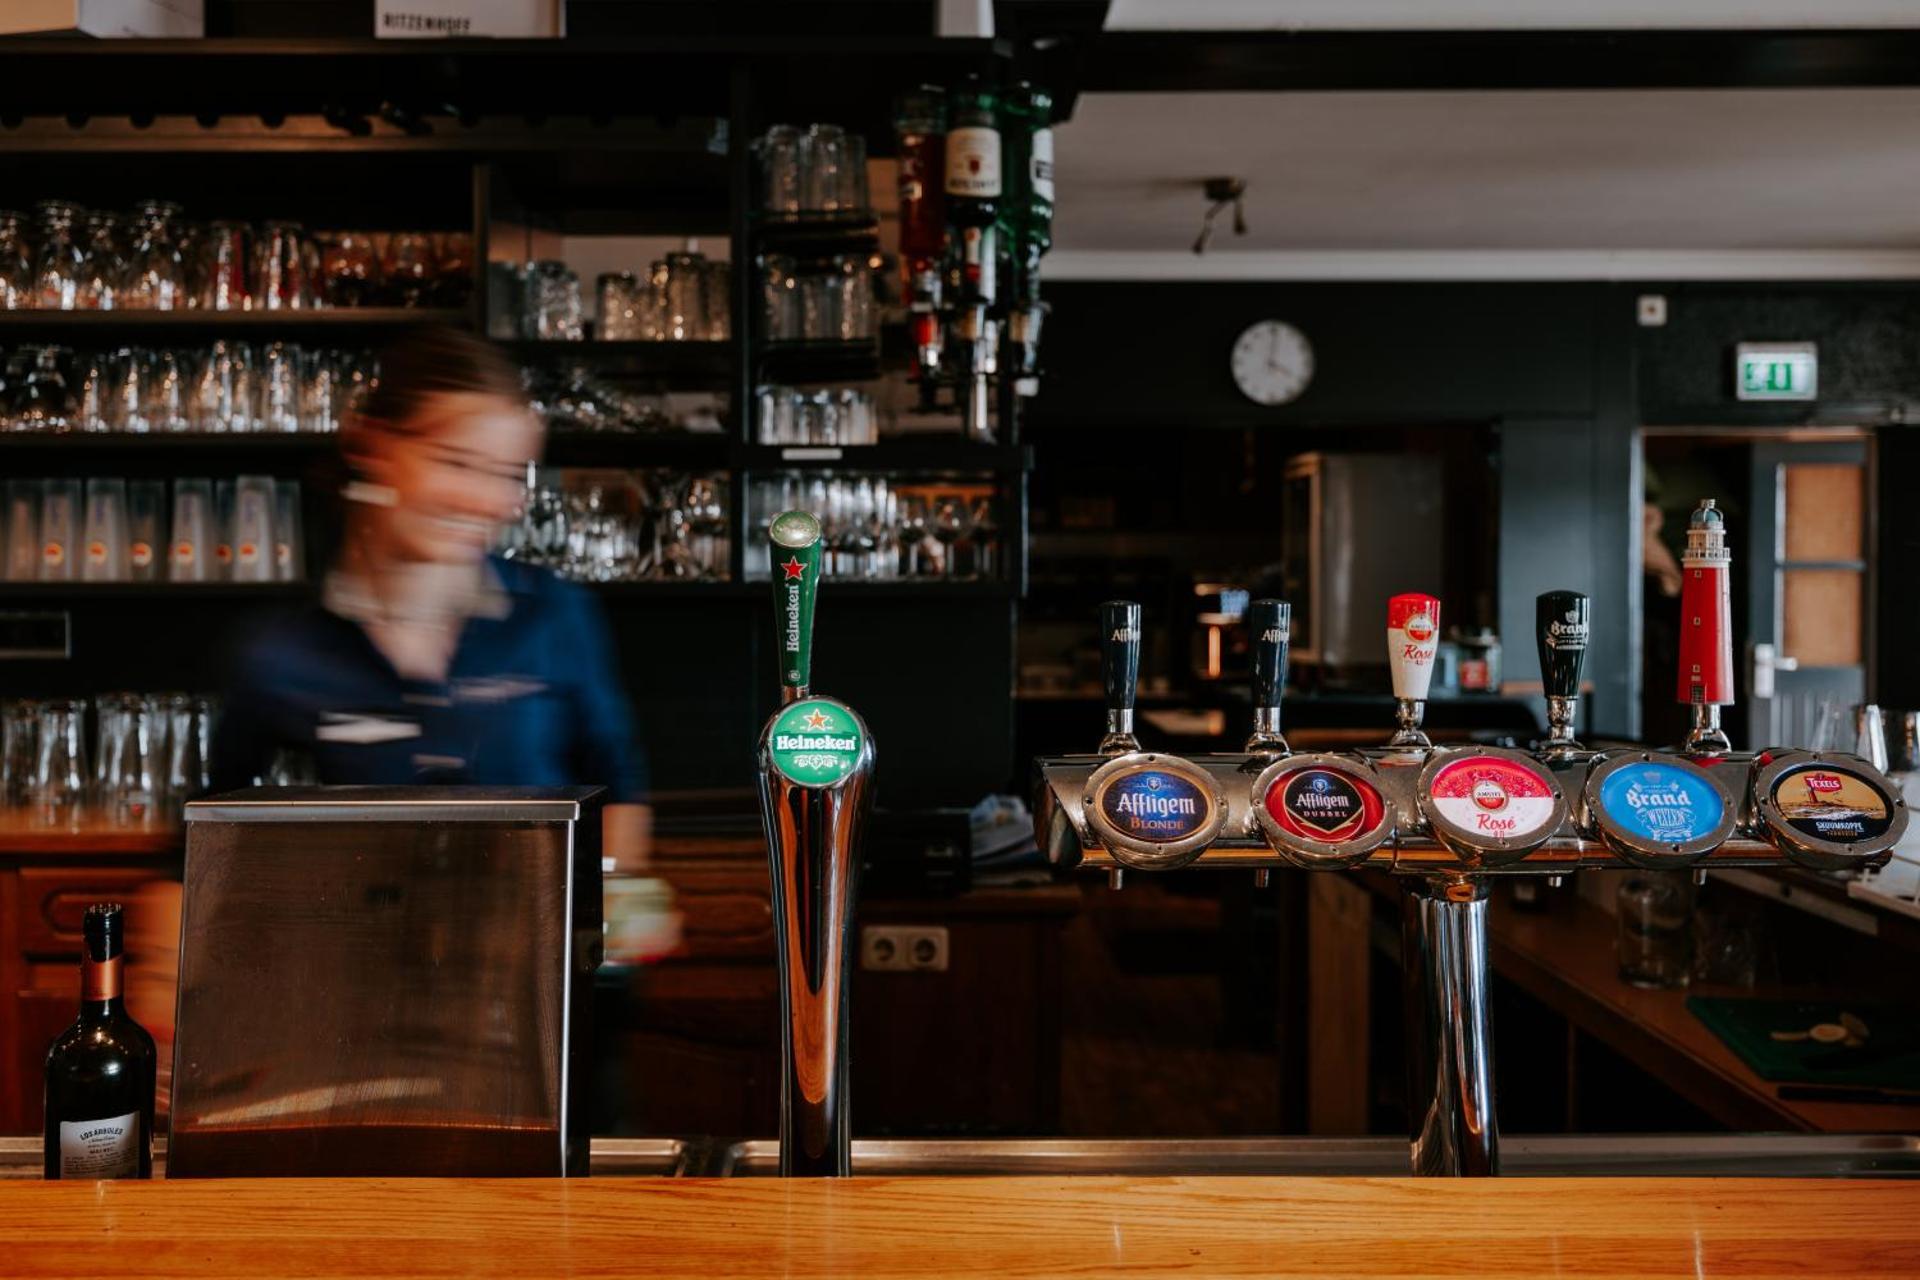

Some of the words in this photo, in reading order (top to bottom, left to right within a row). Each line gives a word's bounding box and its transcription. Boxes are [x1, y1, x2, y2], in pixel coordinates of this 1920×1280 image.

[786, 585, 800, 652] Heineken
[776, 735, 856, 751] Heineken
[1116, 793, 1195, 818] Affligem
[1296, 793, 1349, 810] Affligem
[1626, 788, 1692, 808] Brand
[1476, 813, 1517, 830] Rosé
